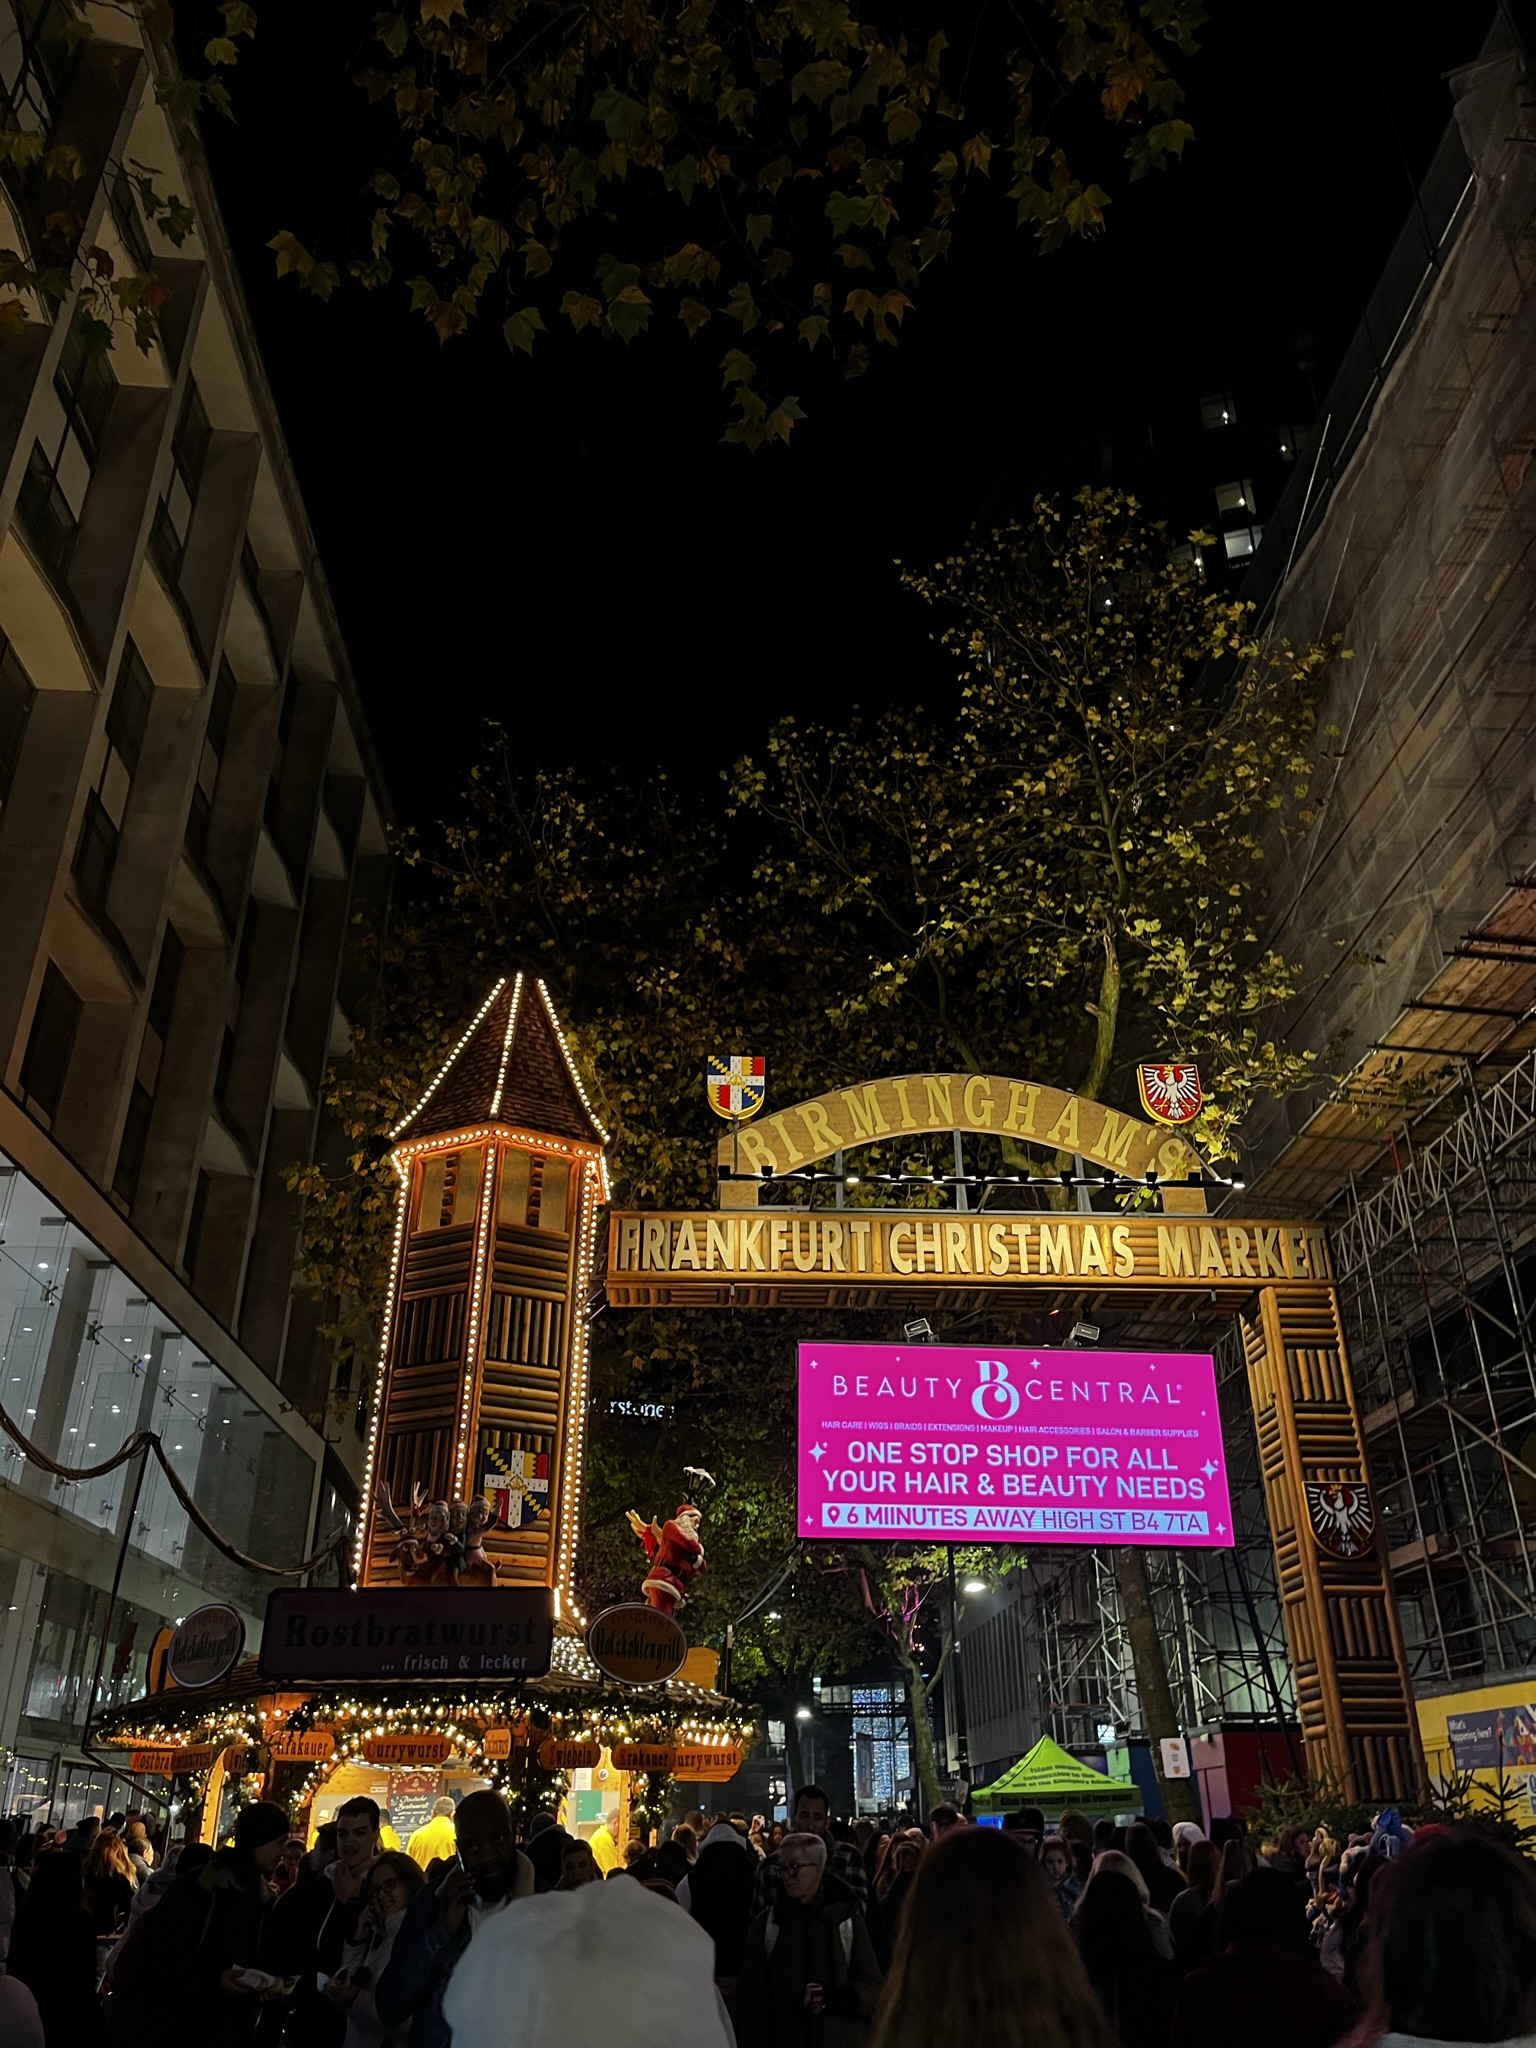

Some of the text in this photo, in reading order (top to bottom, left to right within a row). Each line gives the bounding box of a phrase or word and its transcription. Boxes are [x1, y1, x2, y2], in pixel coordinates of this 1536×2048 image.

[744, 1073, 1189, 1177] BIRMINGHAM'S
[619, 1218, 1327, 1279] FRANKFURT CHRISTMAS MARKET
[833, 1375, 961, 1398] BEAUTY
[822, 1421, 840, 1429] HAIR
[841, 1421, 863, 1429] CARE
[868, 1422, 889, 1430] WIGS
[894, 1422, 922, 1431] BRAIDS
[928, 1423, 975, 1432] EXTENSIONS
[980, 1424, 1013, 1433] MAKEUP
[1039, 1426, 1091, 1435] ACCESSORIES
[1096, 1427, 1123, 1436] SALON
[1130, 1428, 1161, 1437] BARBER
[1162, 1429, 1199, 1437] SUPPLIES
[848, 1441, 1178, 1470] ONE STOP SHOP FOR ALL
[822, 1469, 1206, 1500] YOUR HAIR & BEAUTY NEEDS
[847, 1506, 1203, 1532] 6 MIINUTES AWAY HIGH ST B4 7TA
[284, 1614, 536, 1648] Rostbratwurst
[403, 1654, 448, 1671] frisch
[458, 1655, 471, 1670] &
[480, 1653, 528, 1670] lecker
[276, 1740, 329, 1757] Krakauer
[366, 1740, 445, 1763] Currywurst
[550, 1746, 593, 1766] Zwiebeln
[619, 1747, 669, 1768] Krakauer
[675, 1750, 738, 1771] urrywurst
